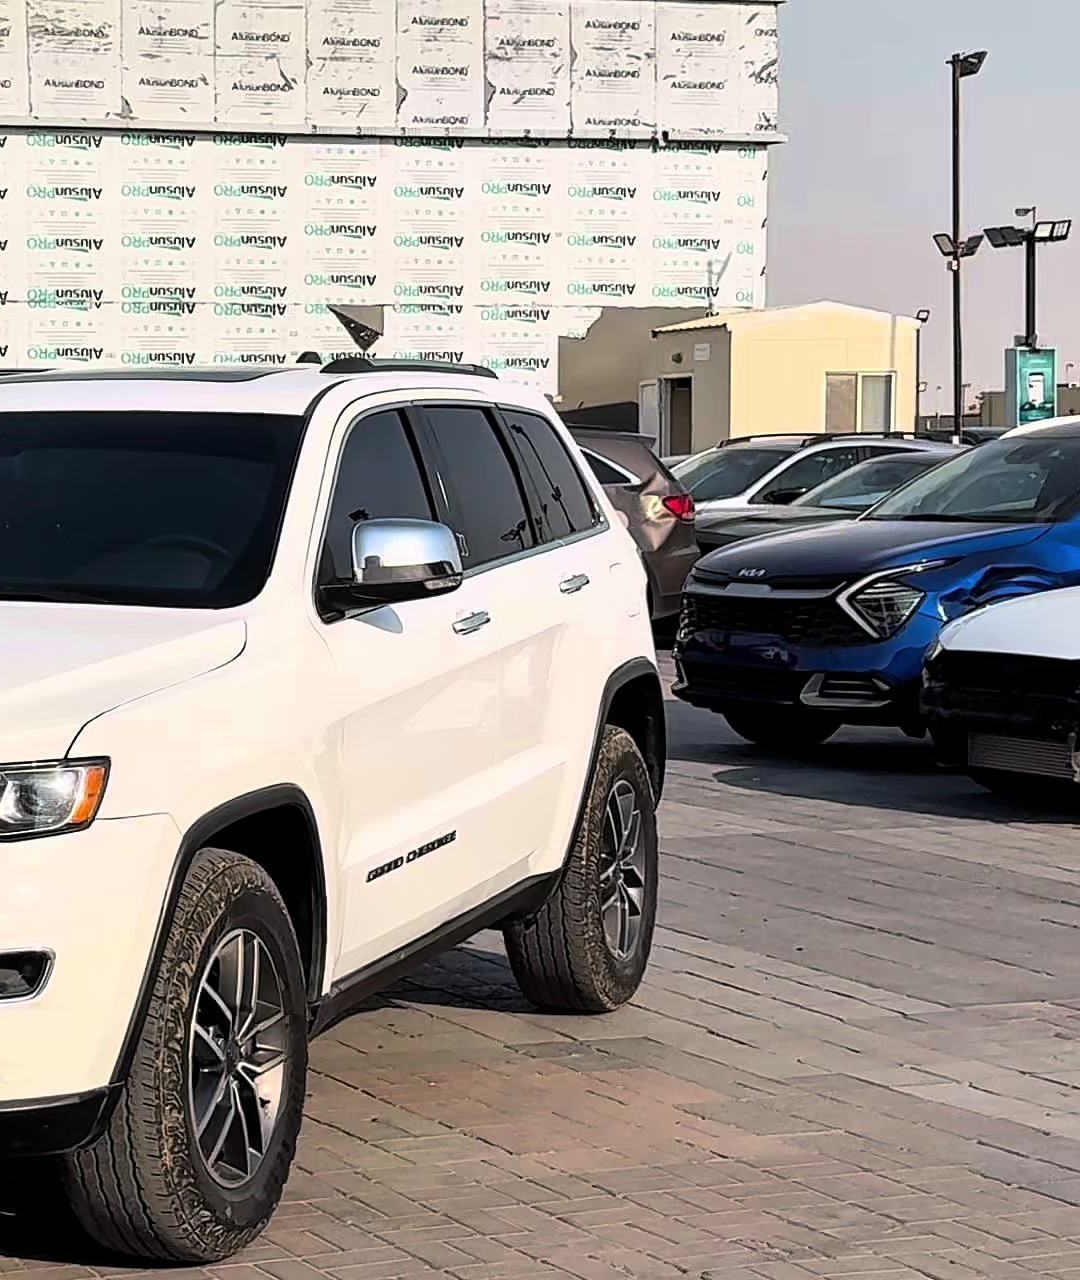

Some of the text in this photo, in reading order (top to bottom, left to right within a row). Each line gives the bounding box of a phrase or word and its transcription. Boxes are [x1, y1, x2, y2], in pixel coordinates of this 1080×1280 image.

[25, 134, 103, 148] AlusunPRO
[121, 134, 195, 147] AlusunPRO
[304, 175, 377, 188] AlusunPRO
[26, 186, 102, 199] AlusunPRO
[121, 184, 195, 198] AlusunPRO
[214, 185, 287, 198] AlusunPRO
[394, 186, 464, 200] AlusunPRO
[481, 182, 551, 196] AlusunPRO
[568, 186, 636, 199] AlusunPRO
[653, 189, 720, 203] AlusunPRO
[304, 225, 377, 238] AlusunPRO
[481, 231, 550, 245] AlusunPRO
[27, 238, 103, 252] AlusunPRO
[121, 236, 196, 249] AlusunPRO
[214, 235, 287, 249] AlusunPRO
[394, 235, 464, 249] AlusunPRO
[567, 235, 636, 248] AlusunPRO
[652, 237, 720, 251] AlusunPRO
[304, 274, 377, 287] AlusunPRO
[480, 280, 550, 293] AlusunPRO
[27, 288, 103, 301] AlusunPRO
[121, 286, 196, 299] AlusunPRO
[214, 285, 287, 299] AlusunPRO
[394, 284, 464, 298] AlusunPRO
[567, 283, 635, 296] AlusunPRO
[652, 285, 719, 298] AlusunPRO
[121, 302, 195, 315] AlusunPRO
[214, 303, 286, 317] AlusunPRO
[480, 308, 550, 321] AlusunPRO
[27, 346, 103, 360] AlusunPRO
[121, 351, 195, 365] AlusunPRO
[480, 357, 549, 370] AlusunPRO
